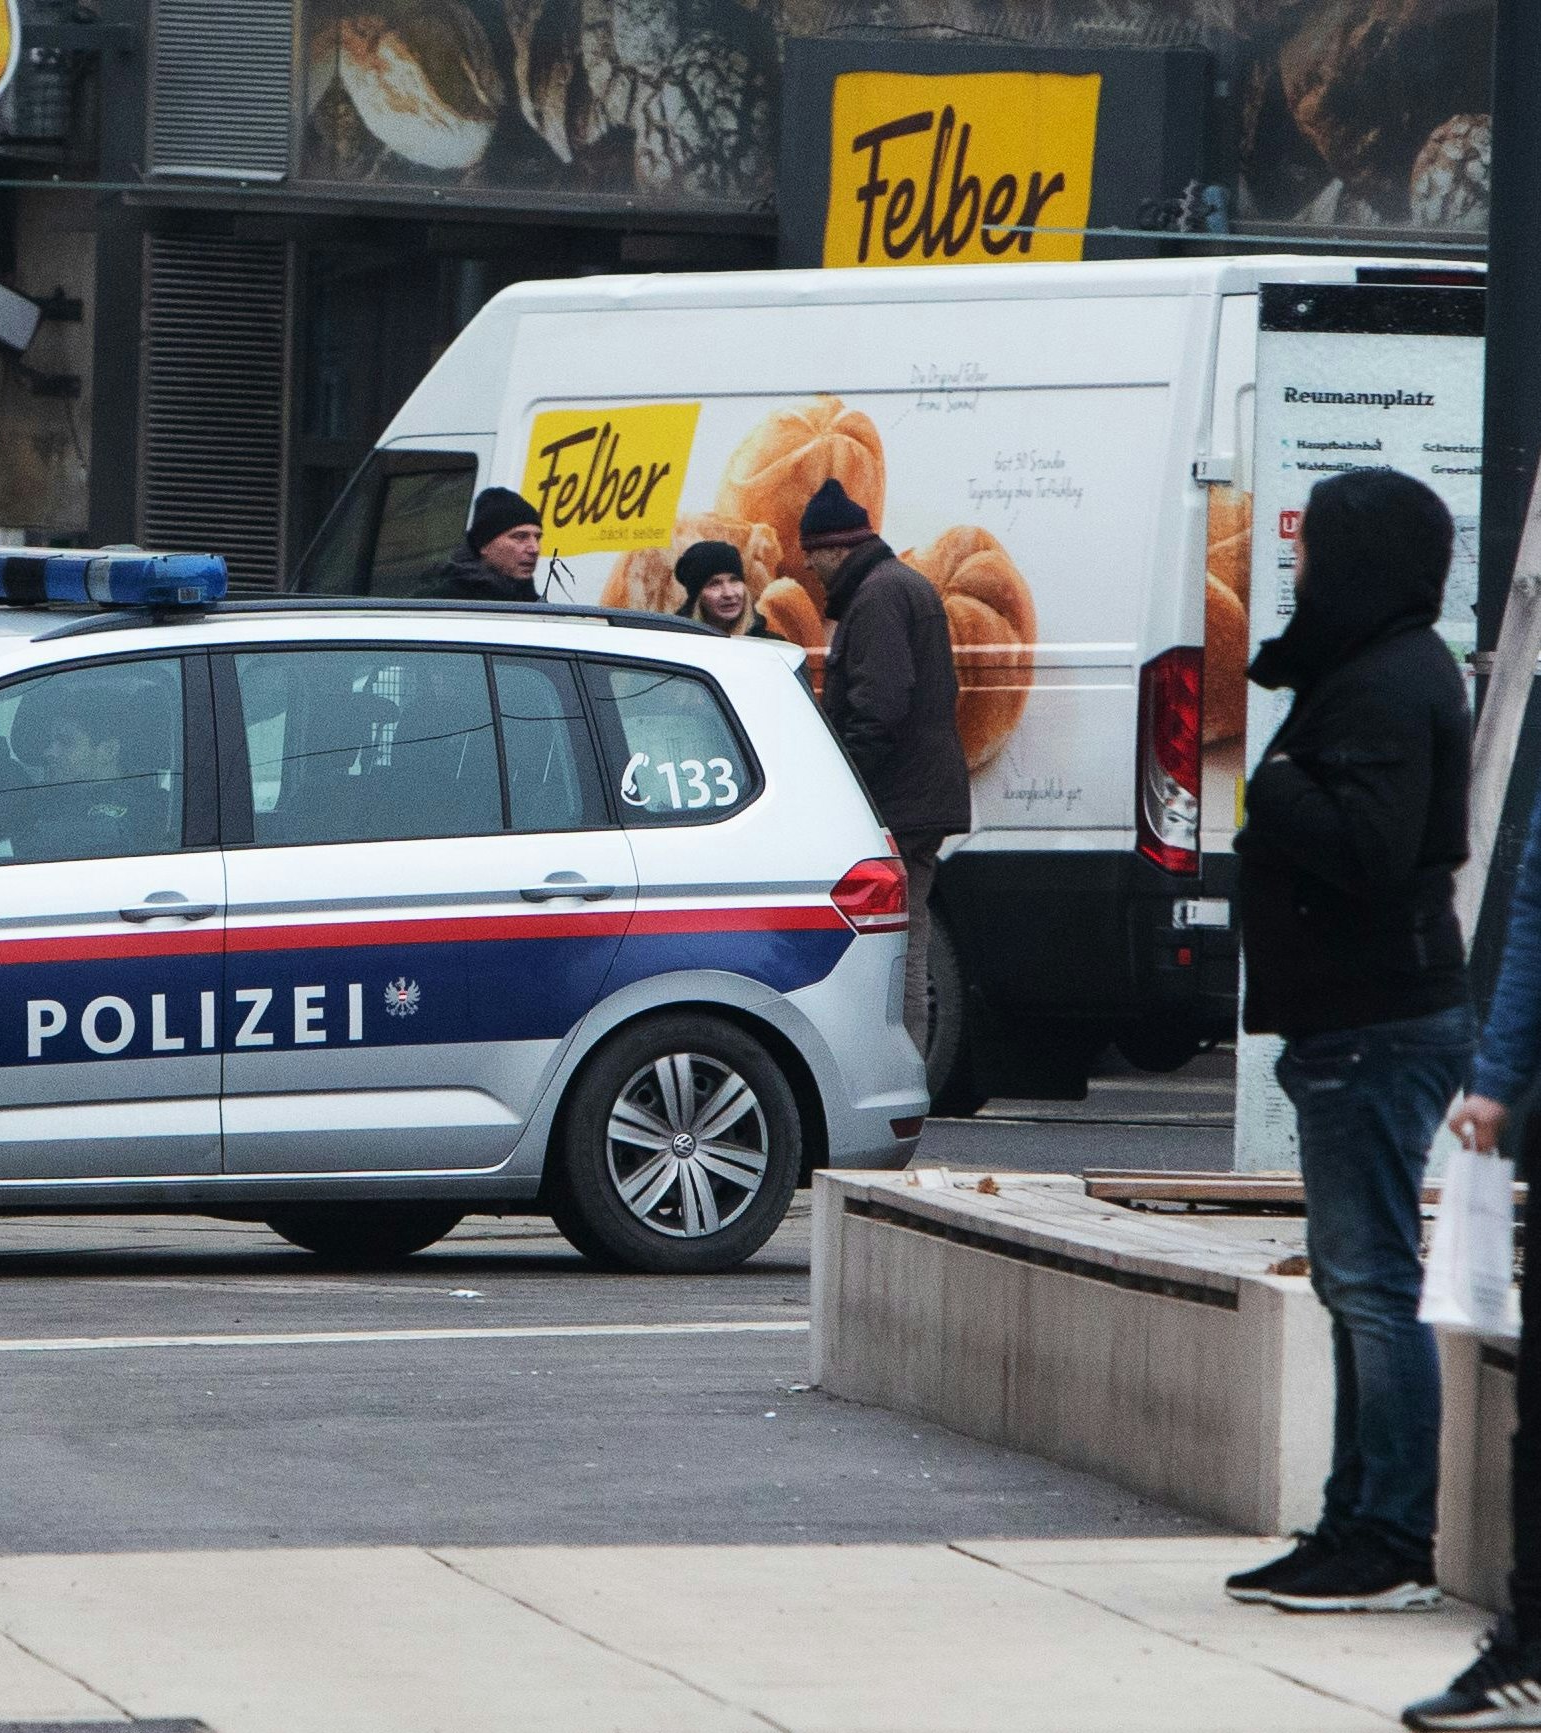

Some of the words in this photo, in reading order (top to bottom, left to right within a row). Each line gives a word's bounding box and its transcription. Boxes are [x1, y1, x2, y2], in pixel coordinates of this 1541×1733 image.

[851, 103, 1066, 264] Felber
[1283, 386, 1435, 410] Reumannplatz
[538, 421, 671, 528] Felber
[1296, 437, 1383, 452] Hauptbahnhof
[656, 757, 739, 810] 133
[26, 982, 363, 1058] POLIZEI
